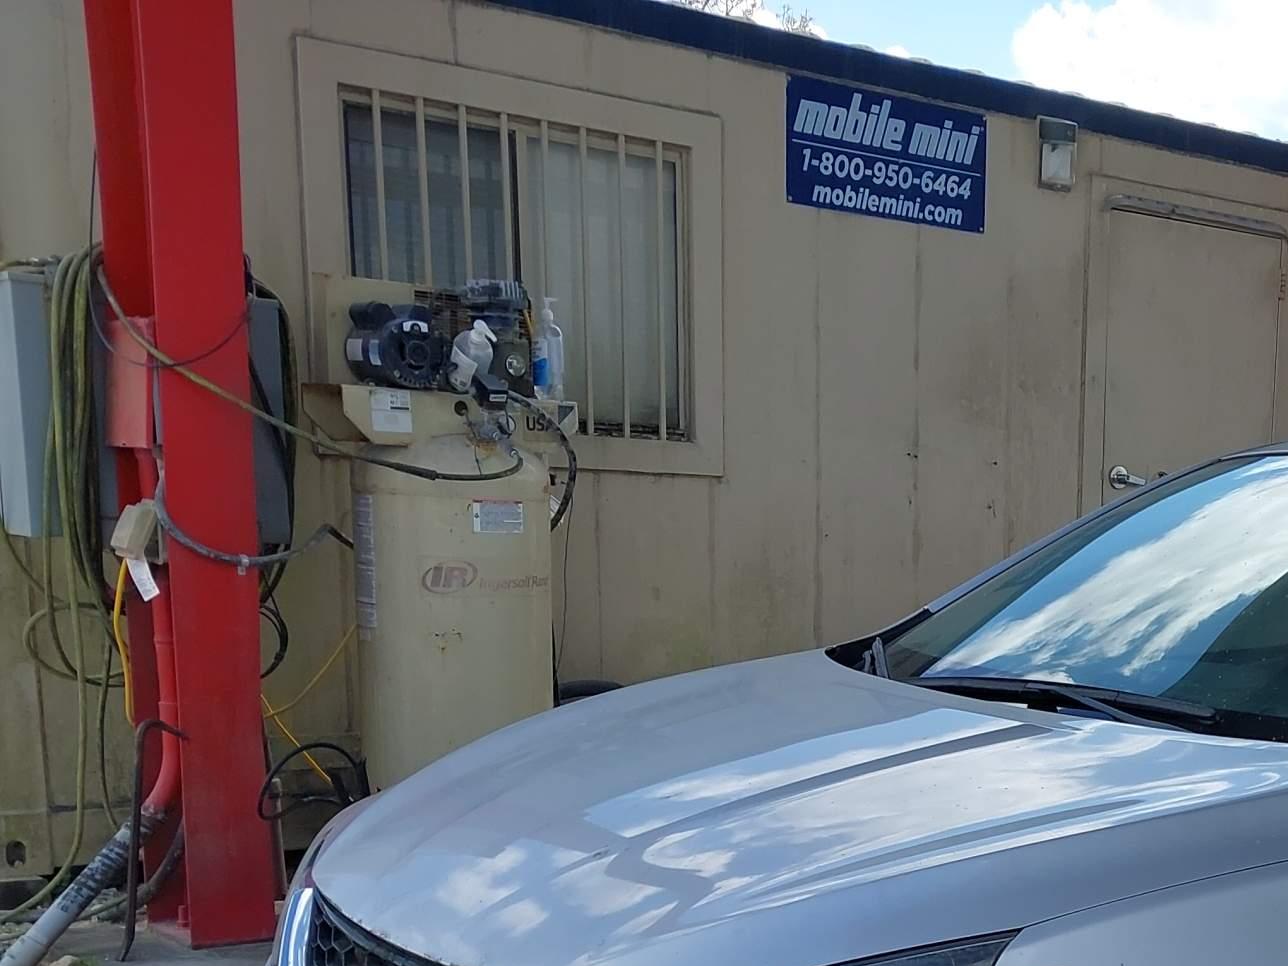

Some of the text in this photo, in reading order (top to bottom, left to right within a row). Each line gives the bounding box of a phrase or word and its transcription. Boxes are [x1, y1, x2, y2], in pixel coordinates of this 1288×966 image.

[793, 92, 981, 165] mobile mini
[801, 149, 972, 199] 1-800-950-6464
[812, 184, 963, 225] mobilemini.com
